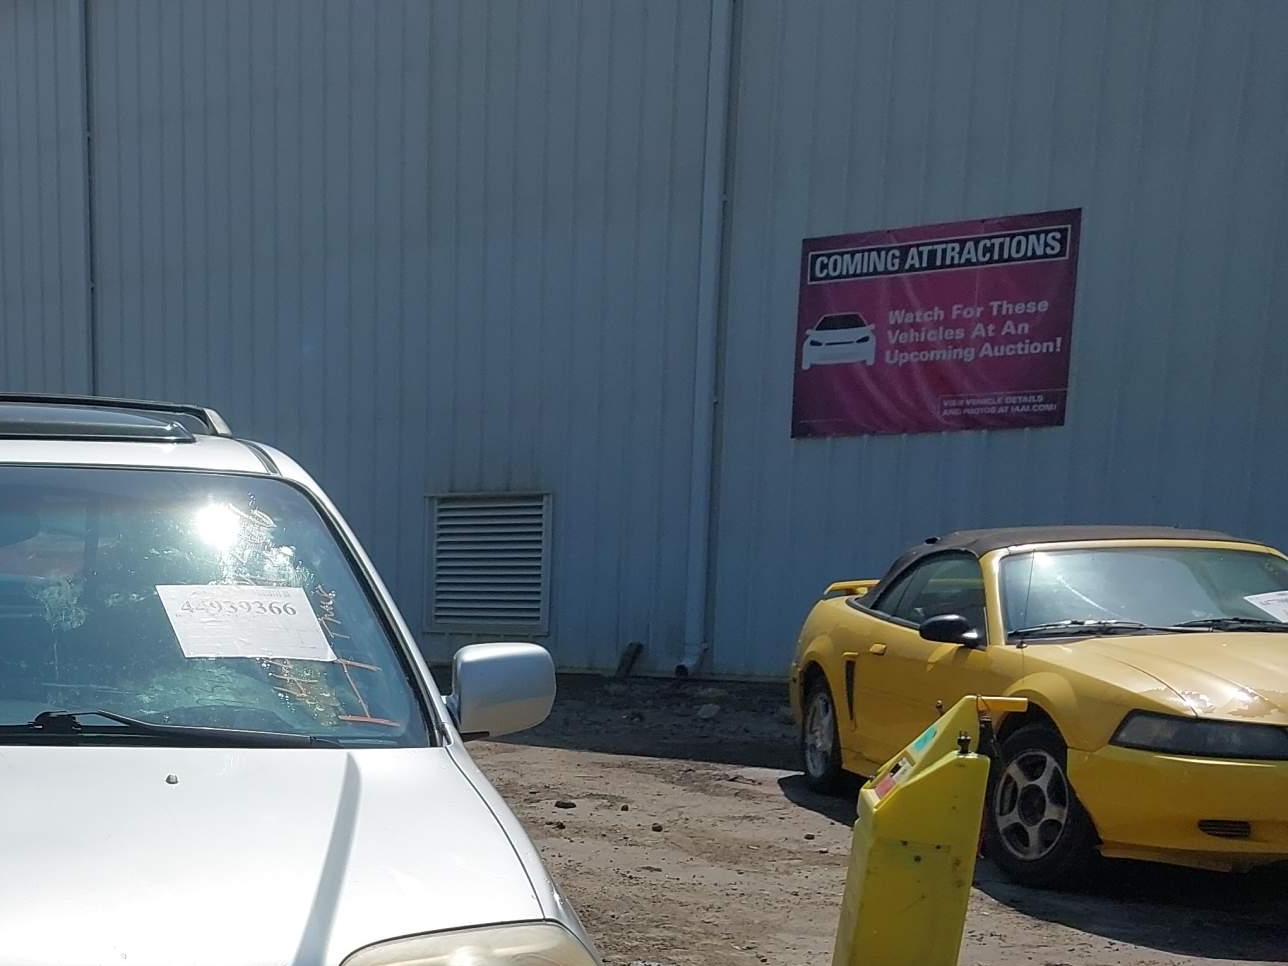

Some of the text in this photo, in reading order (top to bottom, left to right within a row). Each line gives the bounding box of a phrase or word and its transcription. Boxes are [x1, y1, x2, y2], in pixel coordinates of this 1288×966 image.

[815, 232, 1062, 277] COMING ATTRACTIONS
[888, 300, 1049, 324] Watch For These
[887, 320, 1030, 345] Vehicles At An
[885, 336, 1063, 366] Upcoming Auction!
